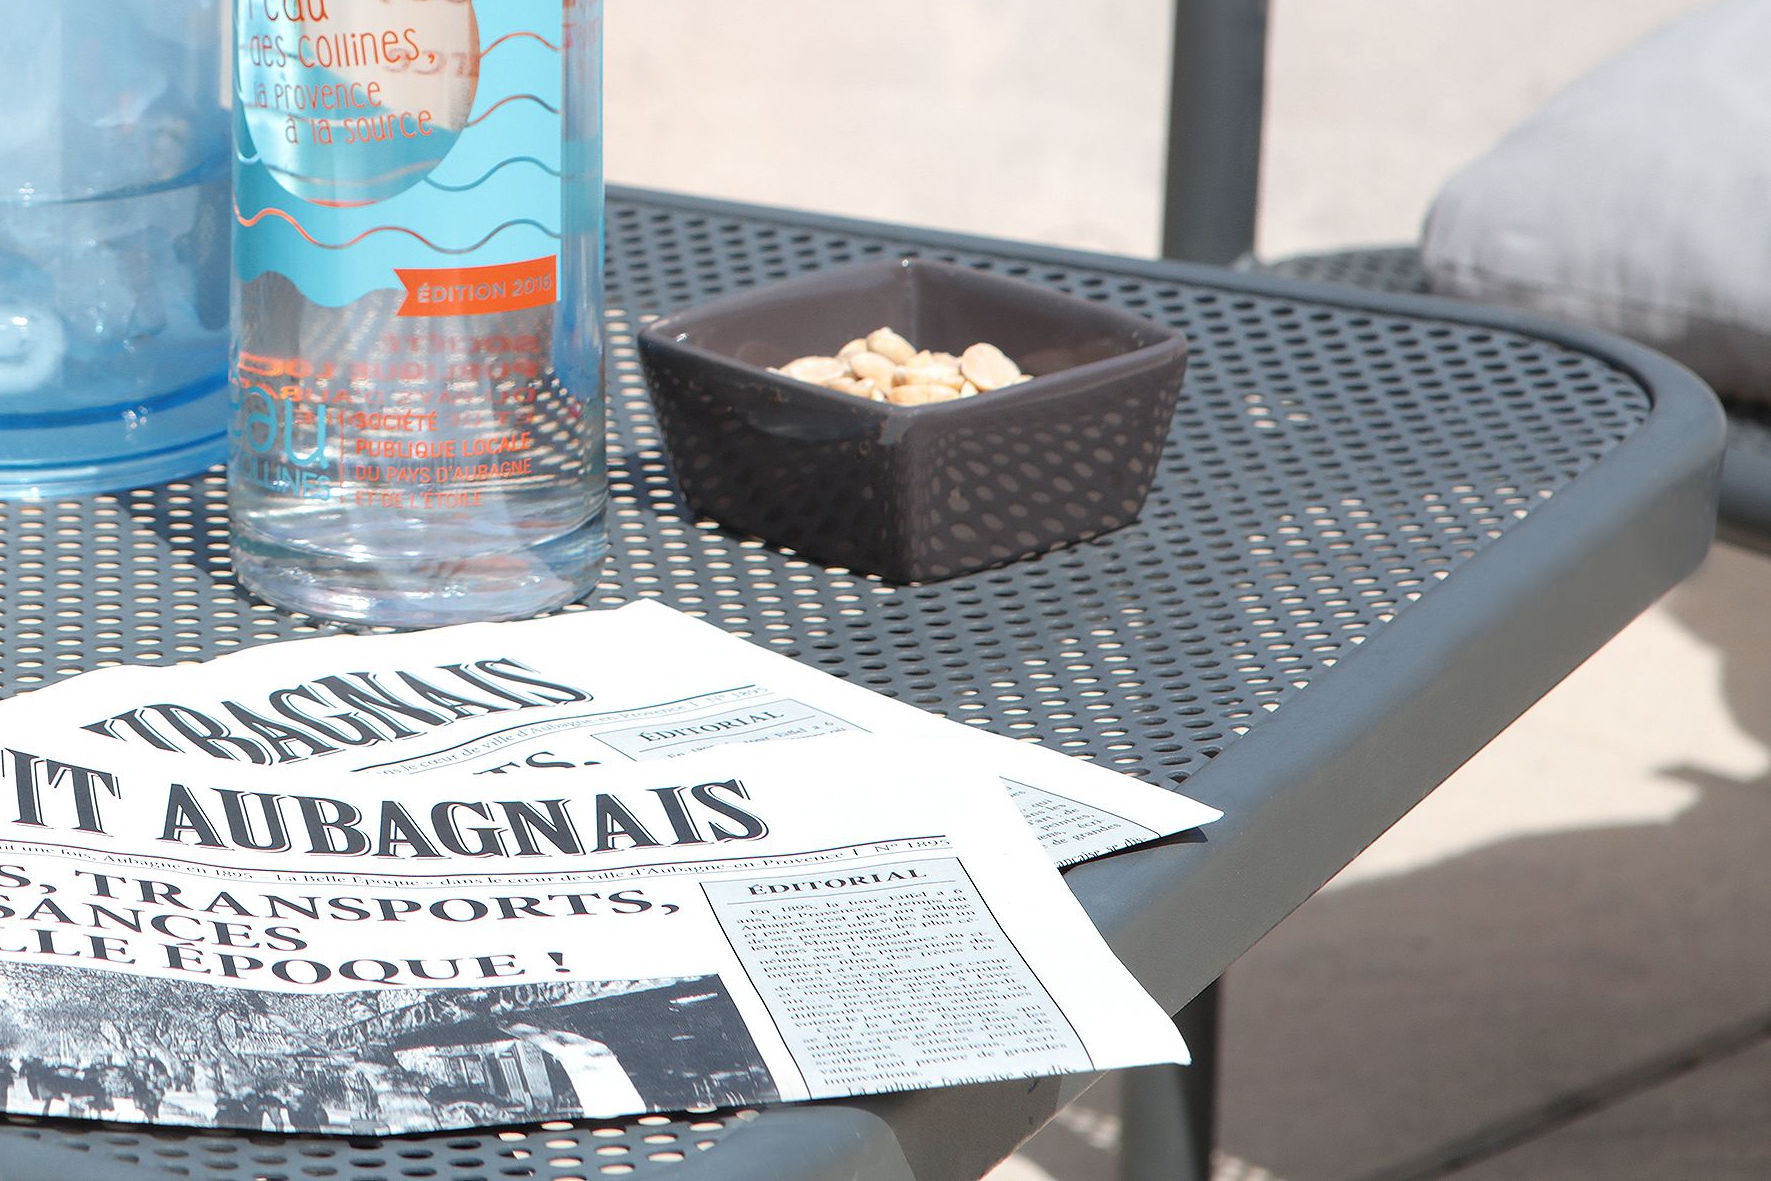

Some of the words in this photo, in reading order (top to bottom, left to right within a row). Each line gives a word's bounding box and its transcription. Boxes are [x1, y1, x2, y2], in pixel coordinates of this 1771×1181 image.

[299, 27, 436, 68] collines,
[312, 119, 332, 145] la
[345, 109, 433, 144] source
[417, 282, 506, 304] ÉDITION
[512, 274, 551, 297] 2016
[355, 409, 438, 432] SOCIÉTÉ
[355, 439, 456, 459] PUBLIQUE
[462, 431, 532, 457] LOCALE
[355, 465, 379, 481] DU
[387, 467, 431, 484] PAYS
[437, 458, 533, 484] D'AUBAGNE
[381, 492, 405, 508] DE
[638, 710, 784, 743] ÉDITORIAL
[156, 778, 770, 860] AUBAGNAIS
[104, 854, 181, 870] Aubagne
[186, 866, 207, 874] en
[304, 875, 346, 884] Belle
[440, 876, 483, 886] dans
[488, 876, 502, 885] le
[560, 874, 581, 883] de
[587, 870, 625, 881] ville
[908, 837, 950, 849] 1895
[75, 870, 680, 922] TRANSPORTS,
[748, 868, 927, 896] ÉDITORIAL
[162, 941, 527, 986] ÉPOQUE
[545, 952, 569, 974] !
